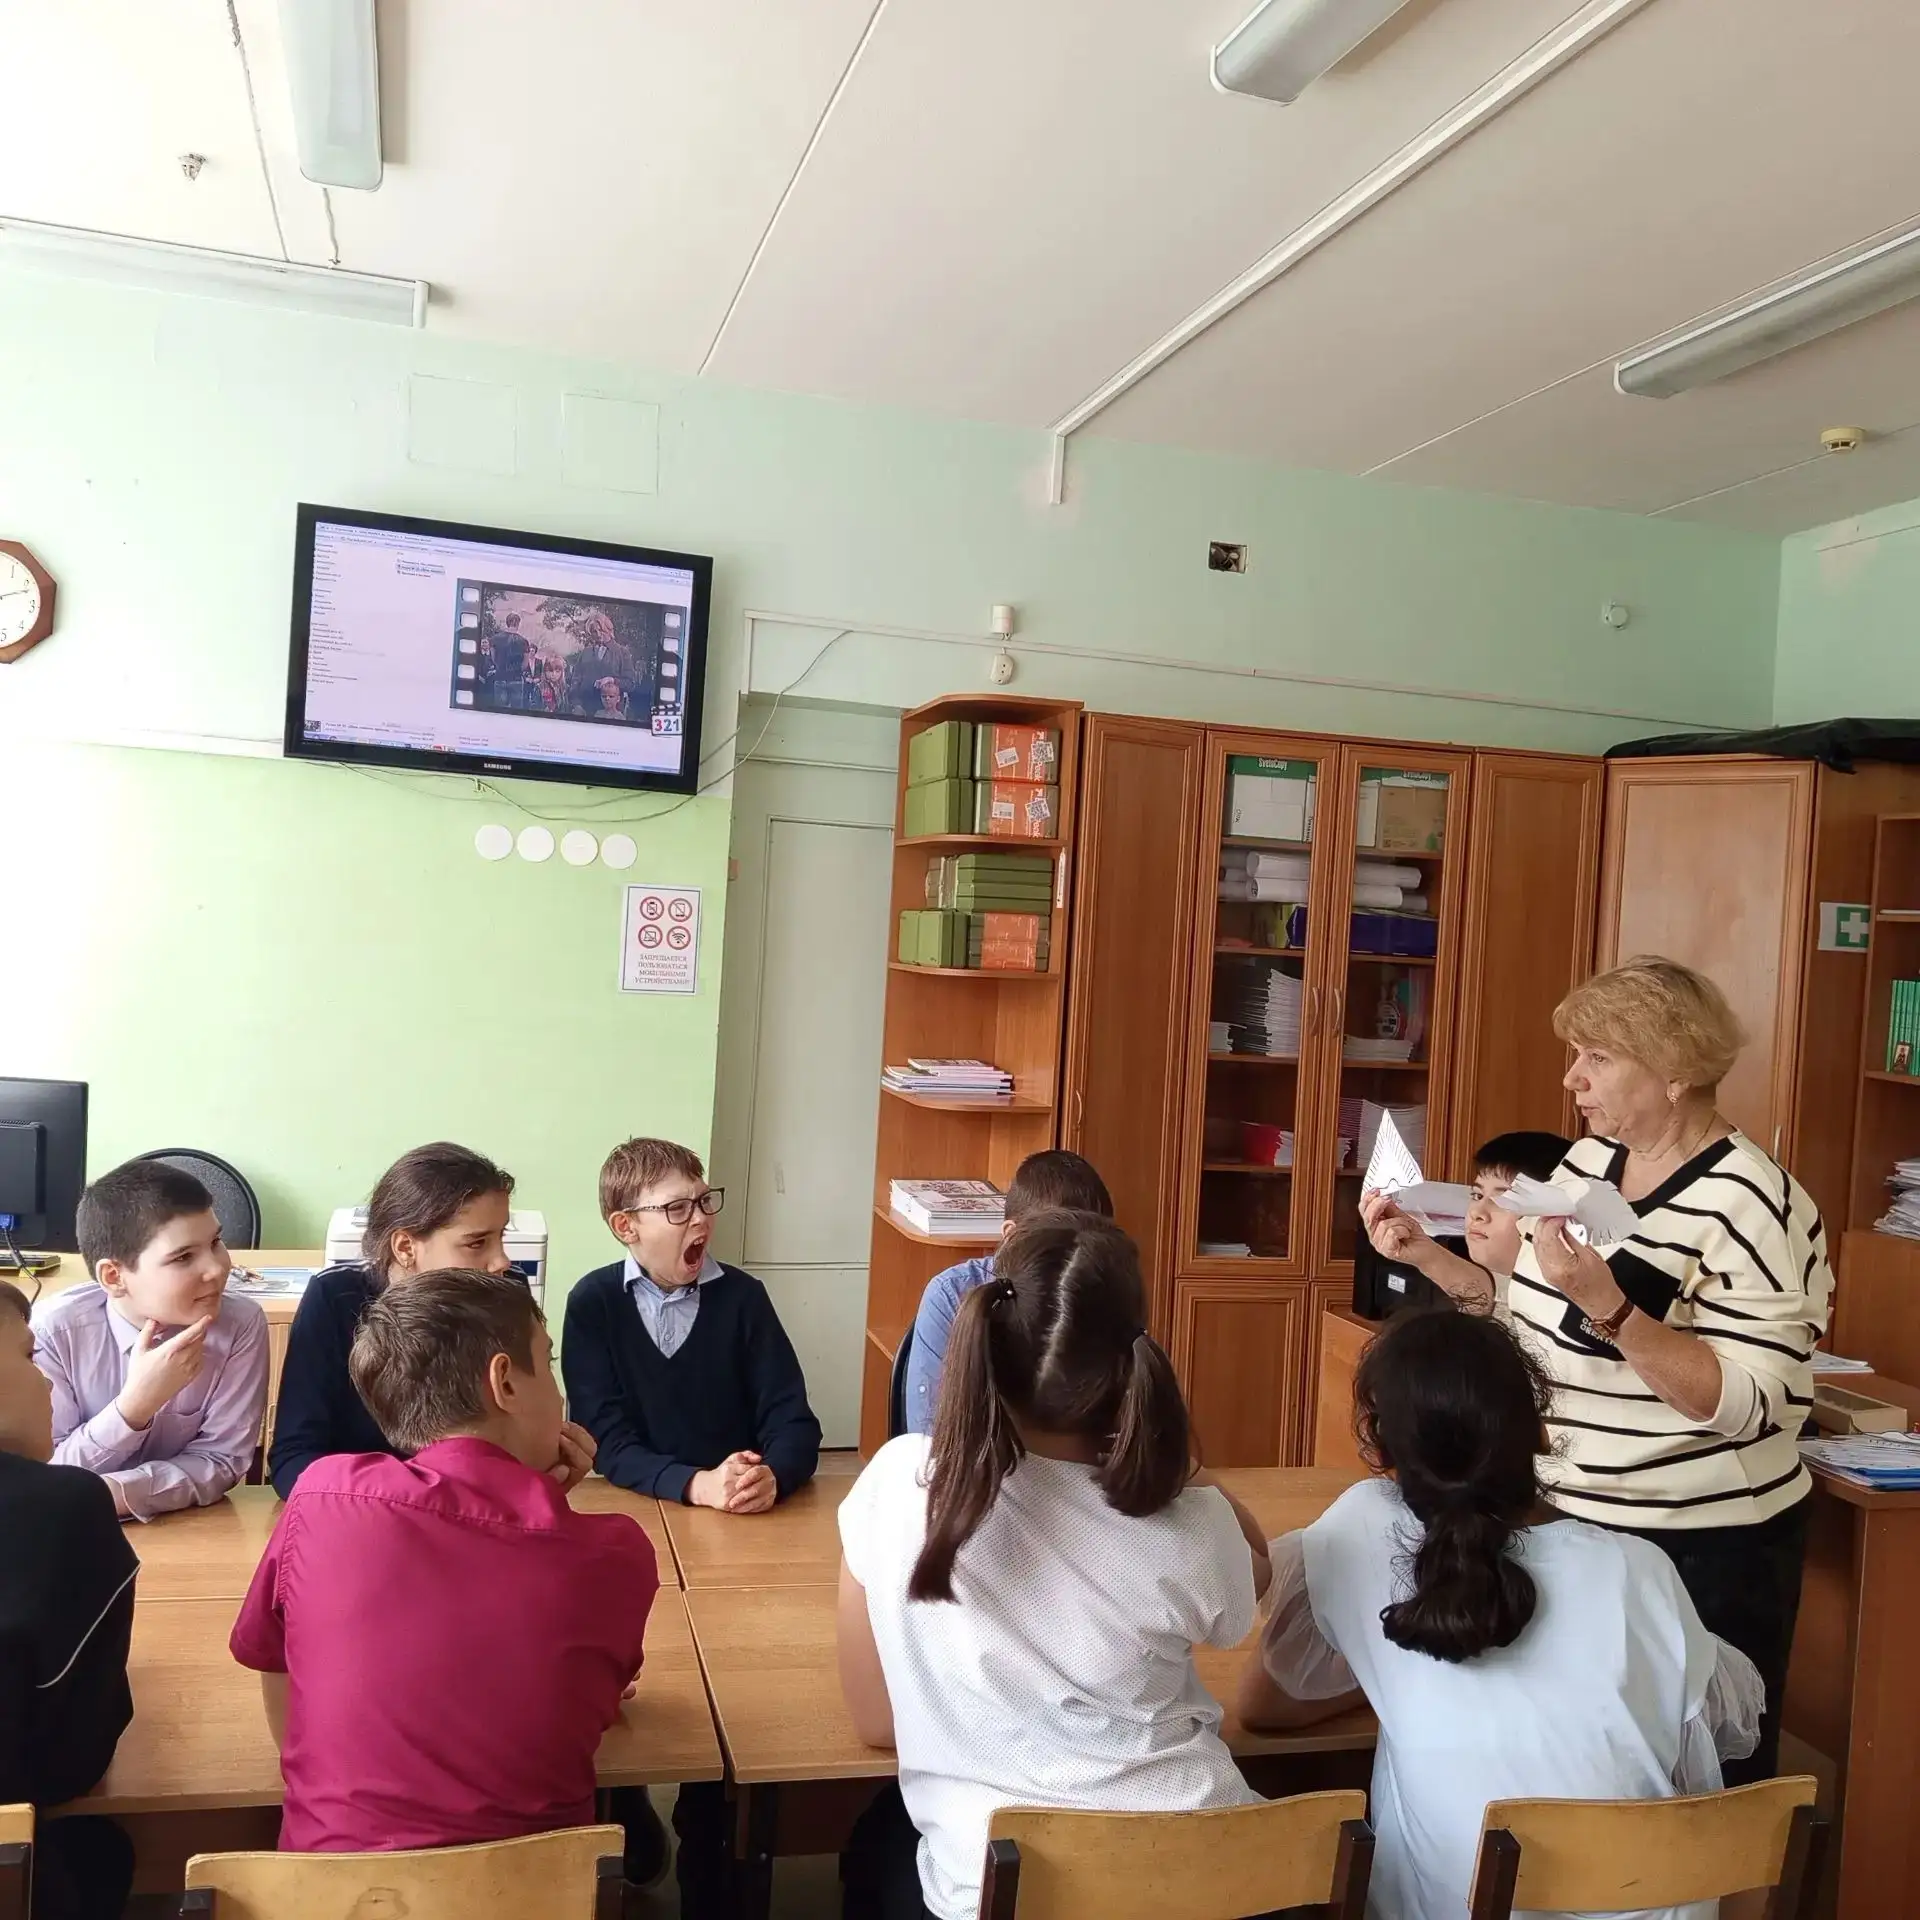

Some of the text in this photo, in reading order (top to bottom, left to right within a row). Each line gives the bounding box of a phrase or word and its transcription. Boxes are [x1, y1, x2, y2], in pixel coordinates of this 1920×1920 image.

[28, 599, 35, 613] 3
[654, 718, 679, 732] 321
[483, 763, 512, 771] SAMSUNG
[1258, 758, 1287, 771] SvetoCopy
[639, 954, 687, 962] ЗАПРЕЩАЕТСЯ
[638, 962, 688, 970] ПОЛЬЗОВАТЬСЯ
